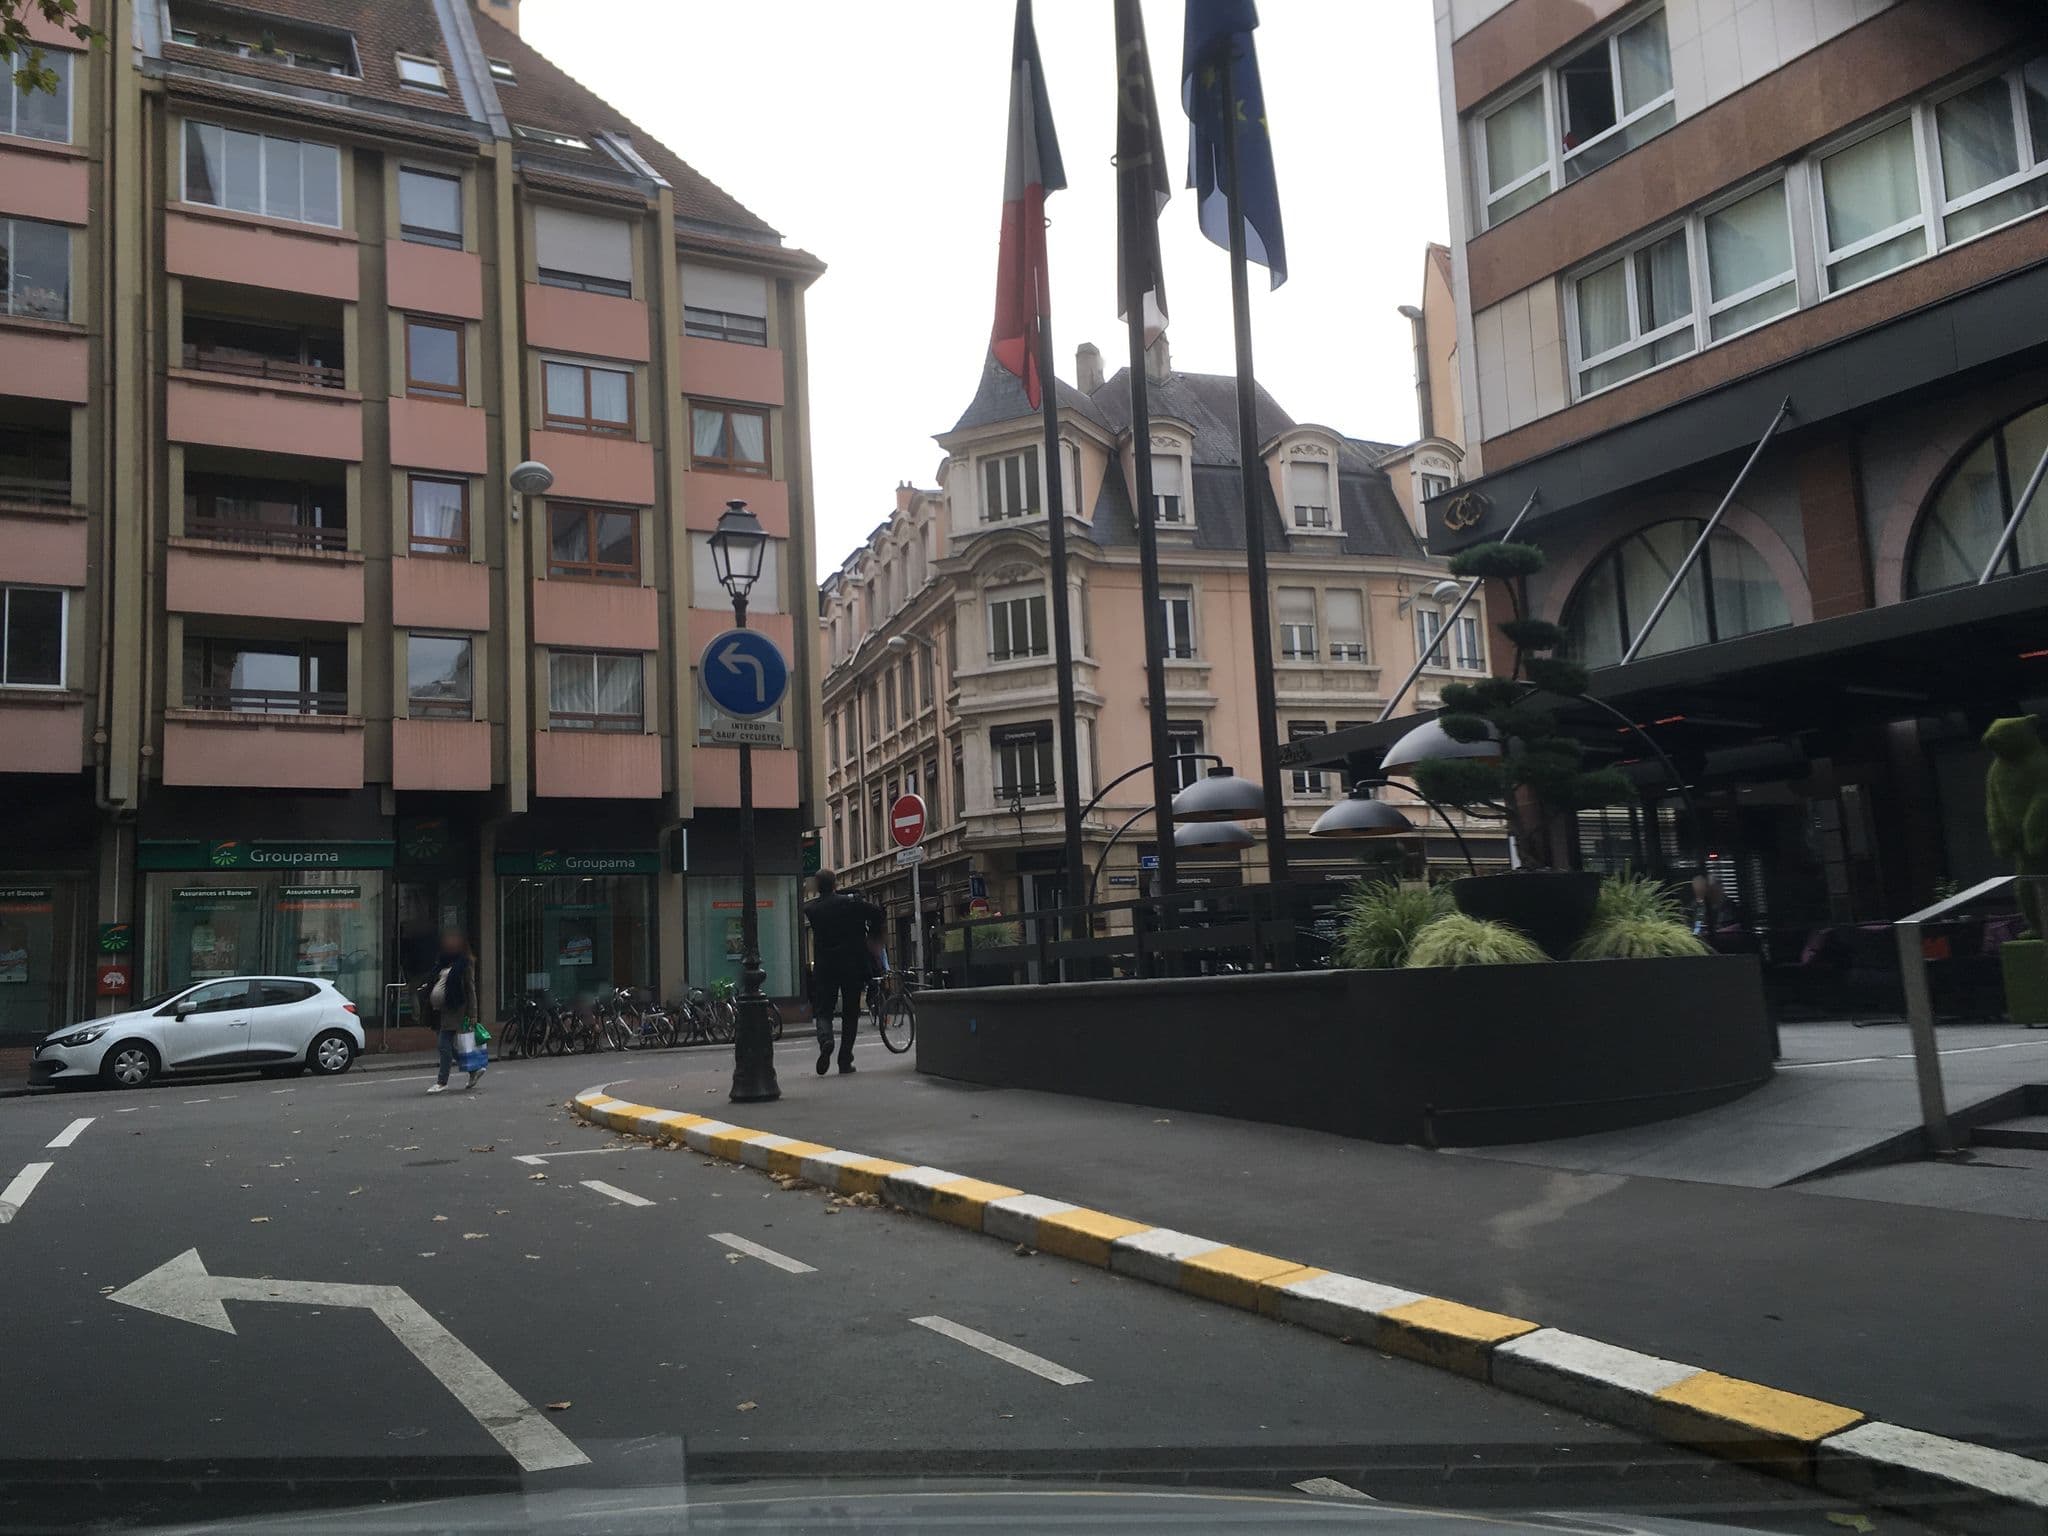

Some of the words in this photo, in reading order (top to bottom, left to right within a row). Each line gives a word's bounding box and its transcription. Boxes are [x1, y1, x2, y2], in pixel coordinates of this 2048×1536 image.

[731, 723, 767, 731] INTERDIT
[740, 733, 781, 741] CYCLISTES
[249, 848, 339, 864] Groupama
[565, 856, 636, 870] Groupama
[179, 889, 216, 897] Assurances
[227, 889, 252, 898] Banque
[286, 888, 321, 896] Assurances
[331, 888, 355, 896] Banque
